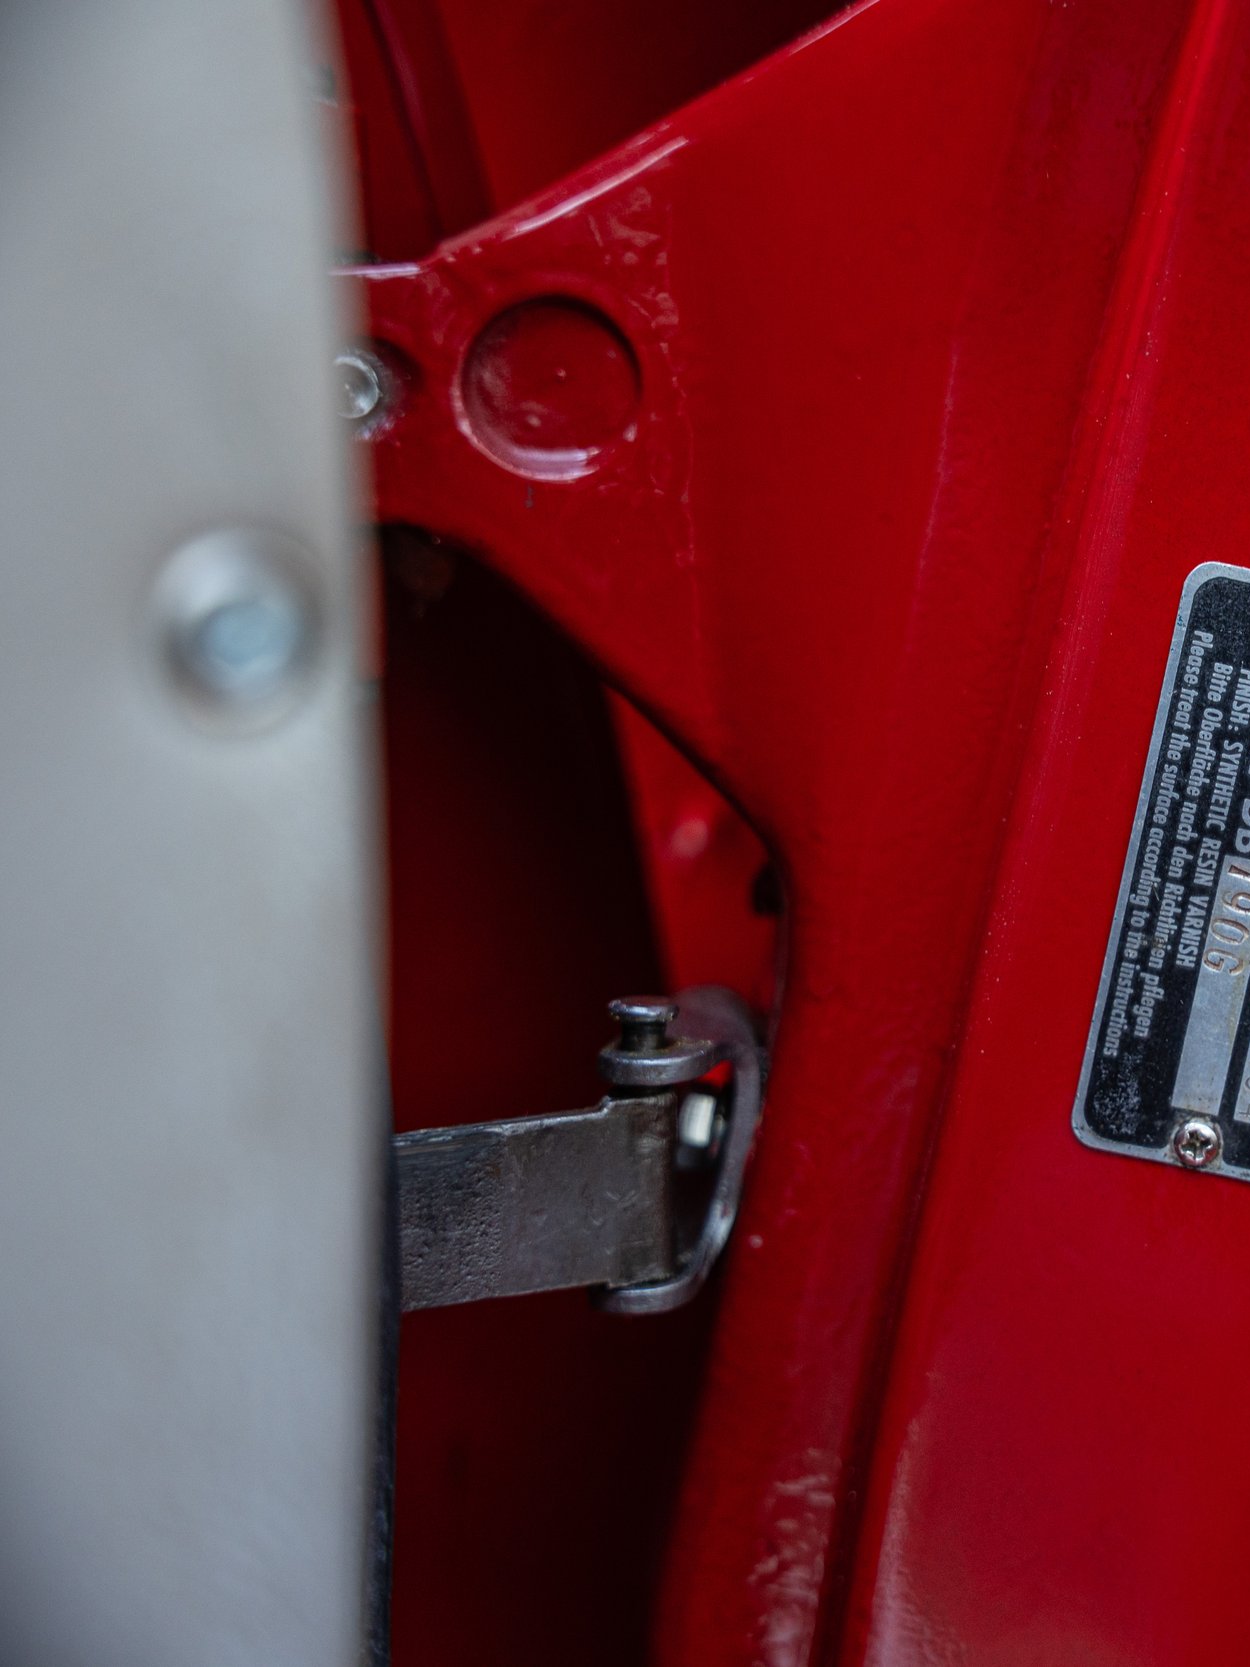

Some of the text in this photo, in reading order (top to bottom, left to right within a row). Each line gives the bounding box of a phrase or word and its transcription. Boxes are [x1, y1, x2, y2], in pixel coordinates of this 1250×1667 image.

[1205, 739, 1243, 832] SYNTHETIC
[1101, 629, 1215, 1058] Please treat the surface according to the instructions
[1127, 662, 1233, 1039] Bitte Oberfläche nach den Richtlinien pflegen
[1192, 837, 1221, 886] RESIN
[1175, 893, 1209, 968] VARNISH
